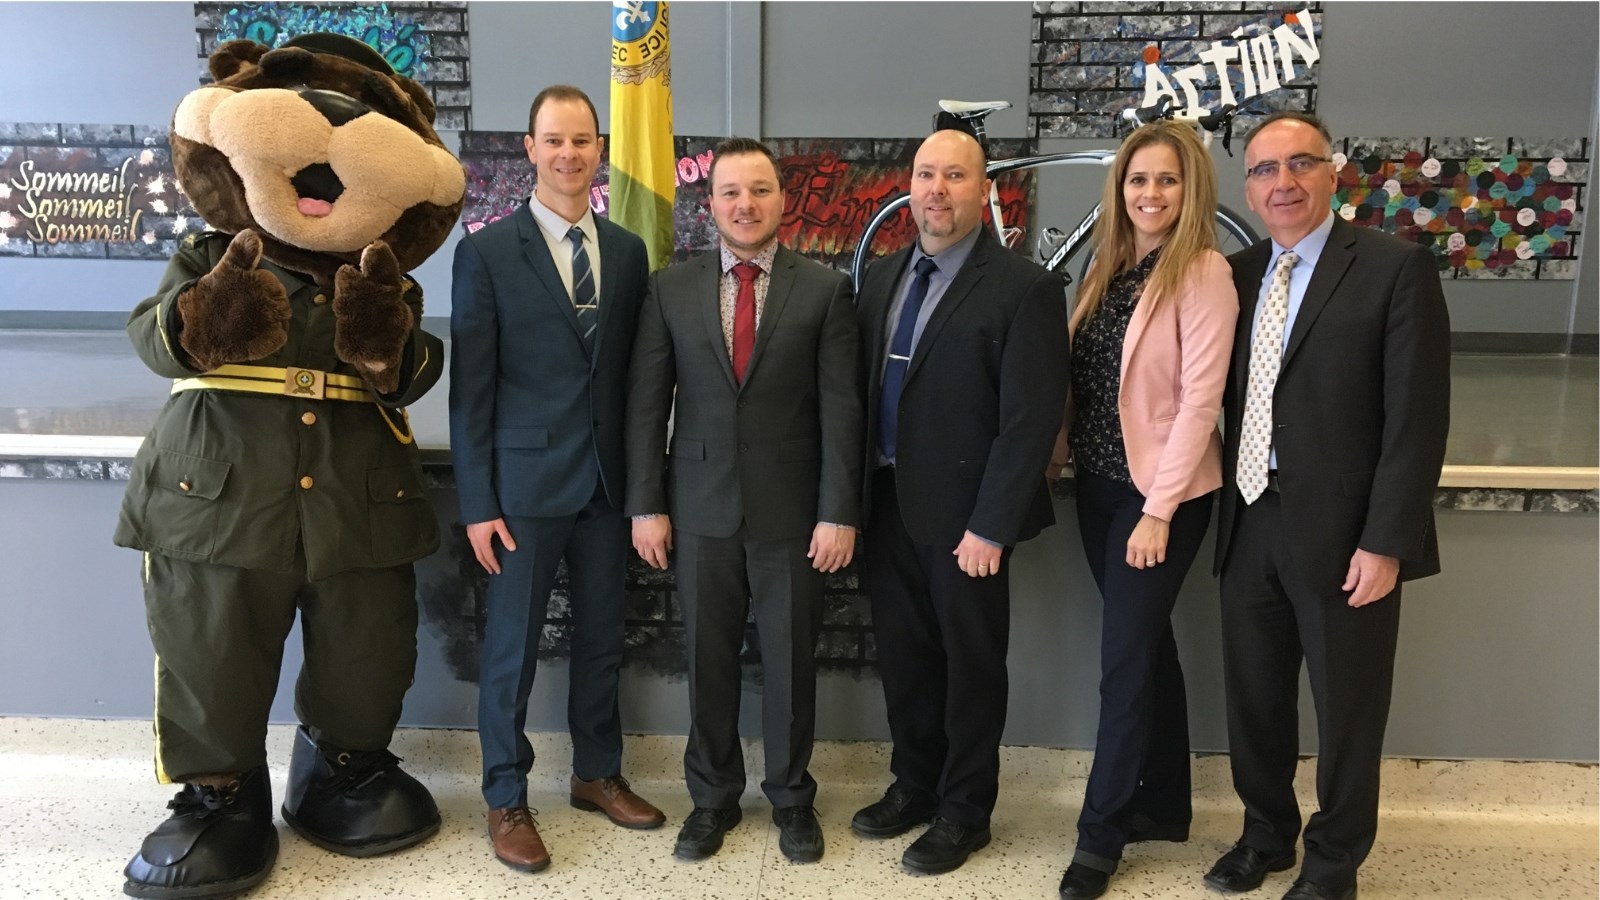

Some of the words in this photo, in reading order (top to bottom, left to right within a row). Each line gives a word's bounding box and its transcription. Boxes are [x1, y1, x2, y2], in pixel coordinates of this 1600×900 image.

[11, 157, 133, 194] Sommeil
[17, 183, 138, 219] Sommeil
[26, 209, 143, 243] Sommeil
